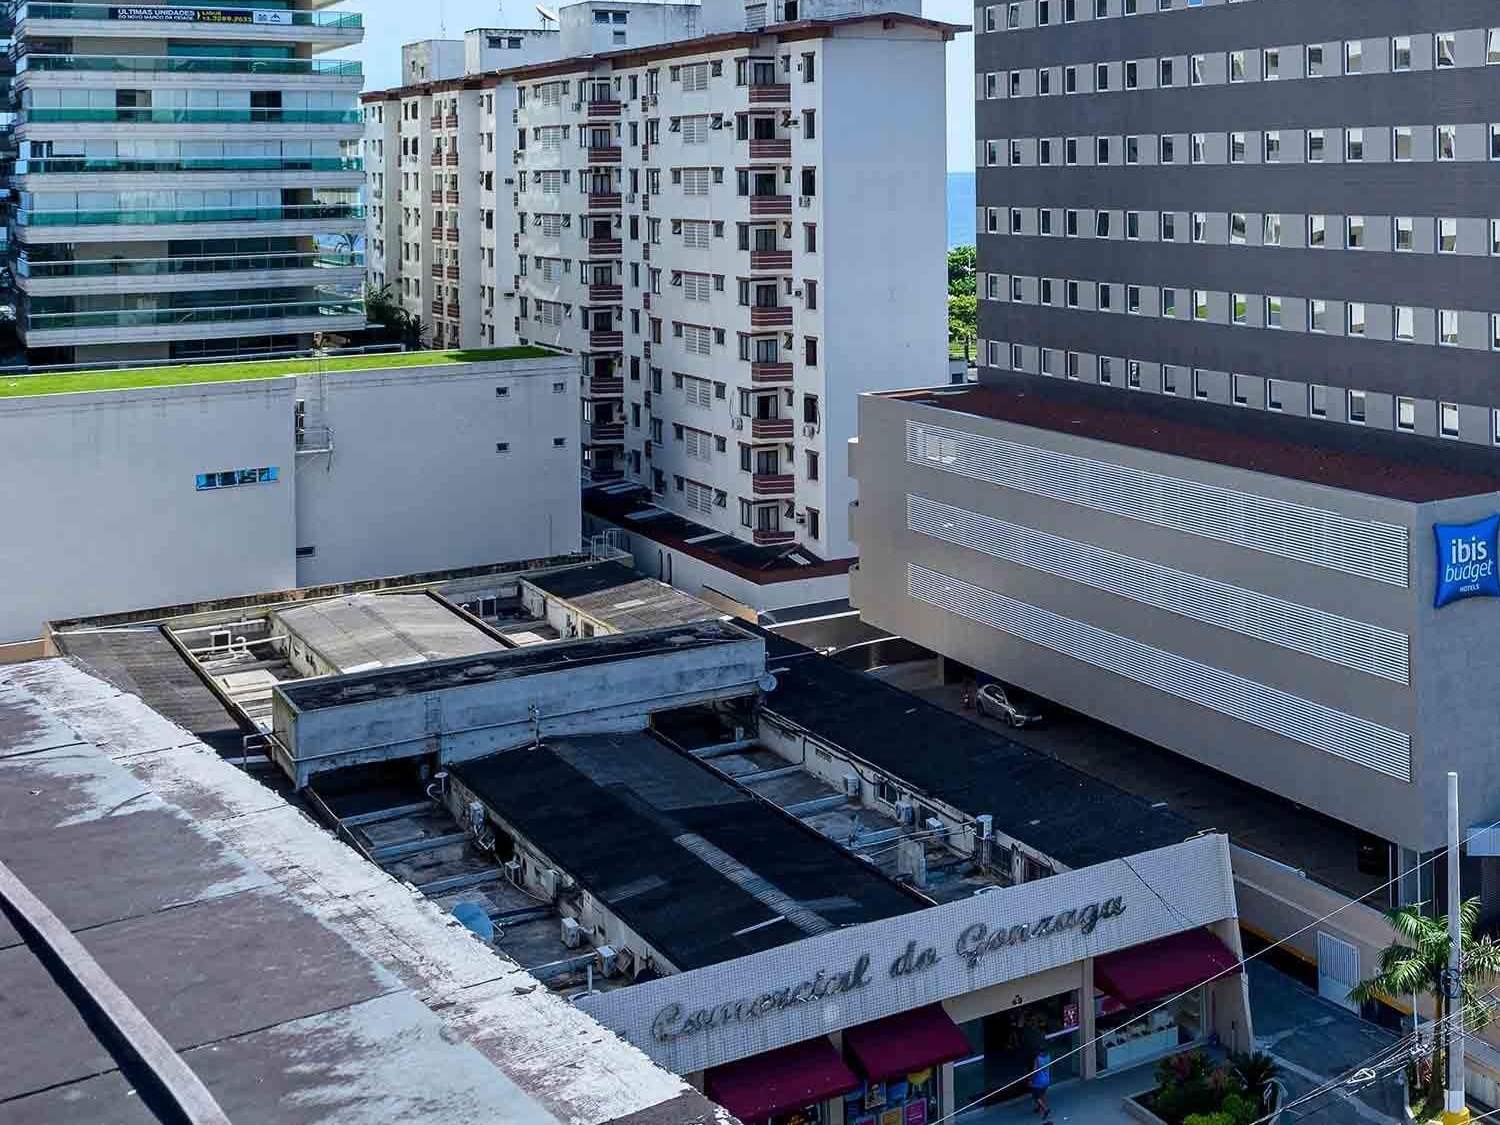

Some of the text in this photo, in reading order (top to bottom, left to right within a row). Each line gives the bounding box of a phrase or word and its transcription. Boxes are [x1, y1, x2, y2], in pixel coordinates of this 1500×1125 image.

[1450, 536, 1488, 564] ibis
[1445, 559, 1494, 583] budget
[651, 952, 872, 1042] Comercial
[956, 895, 1127, 969] Gonzaga
